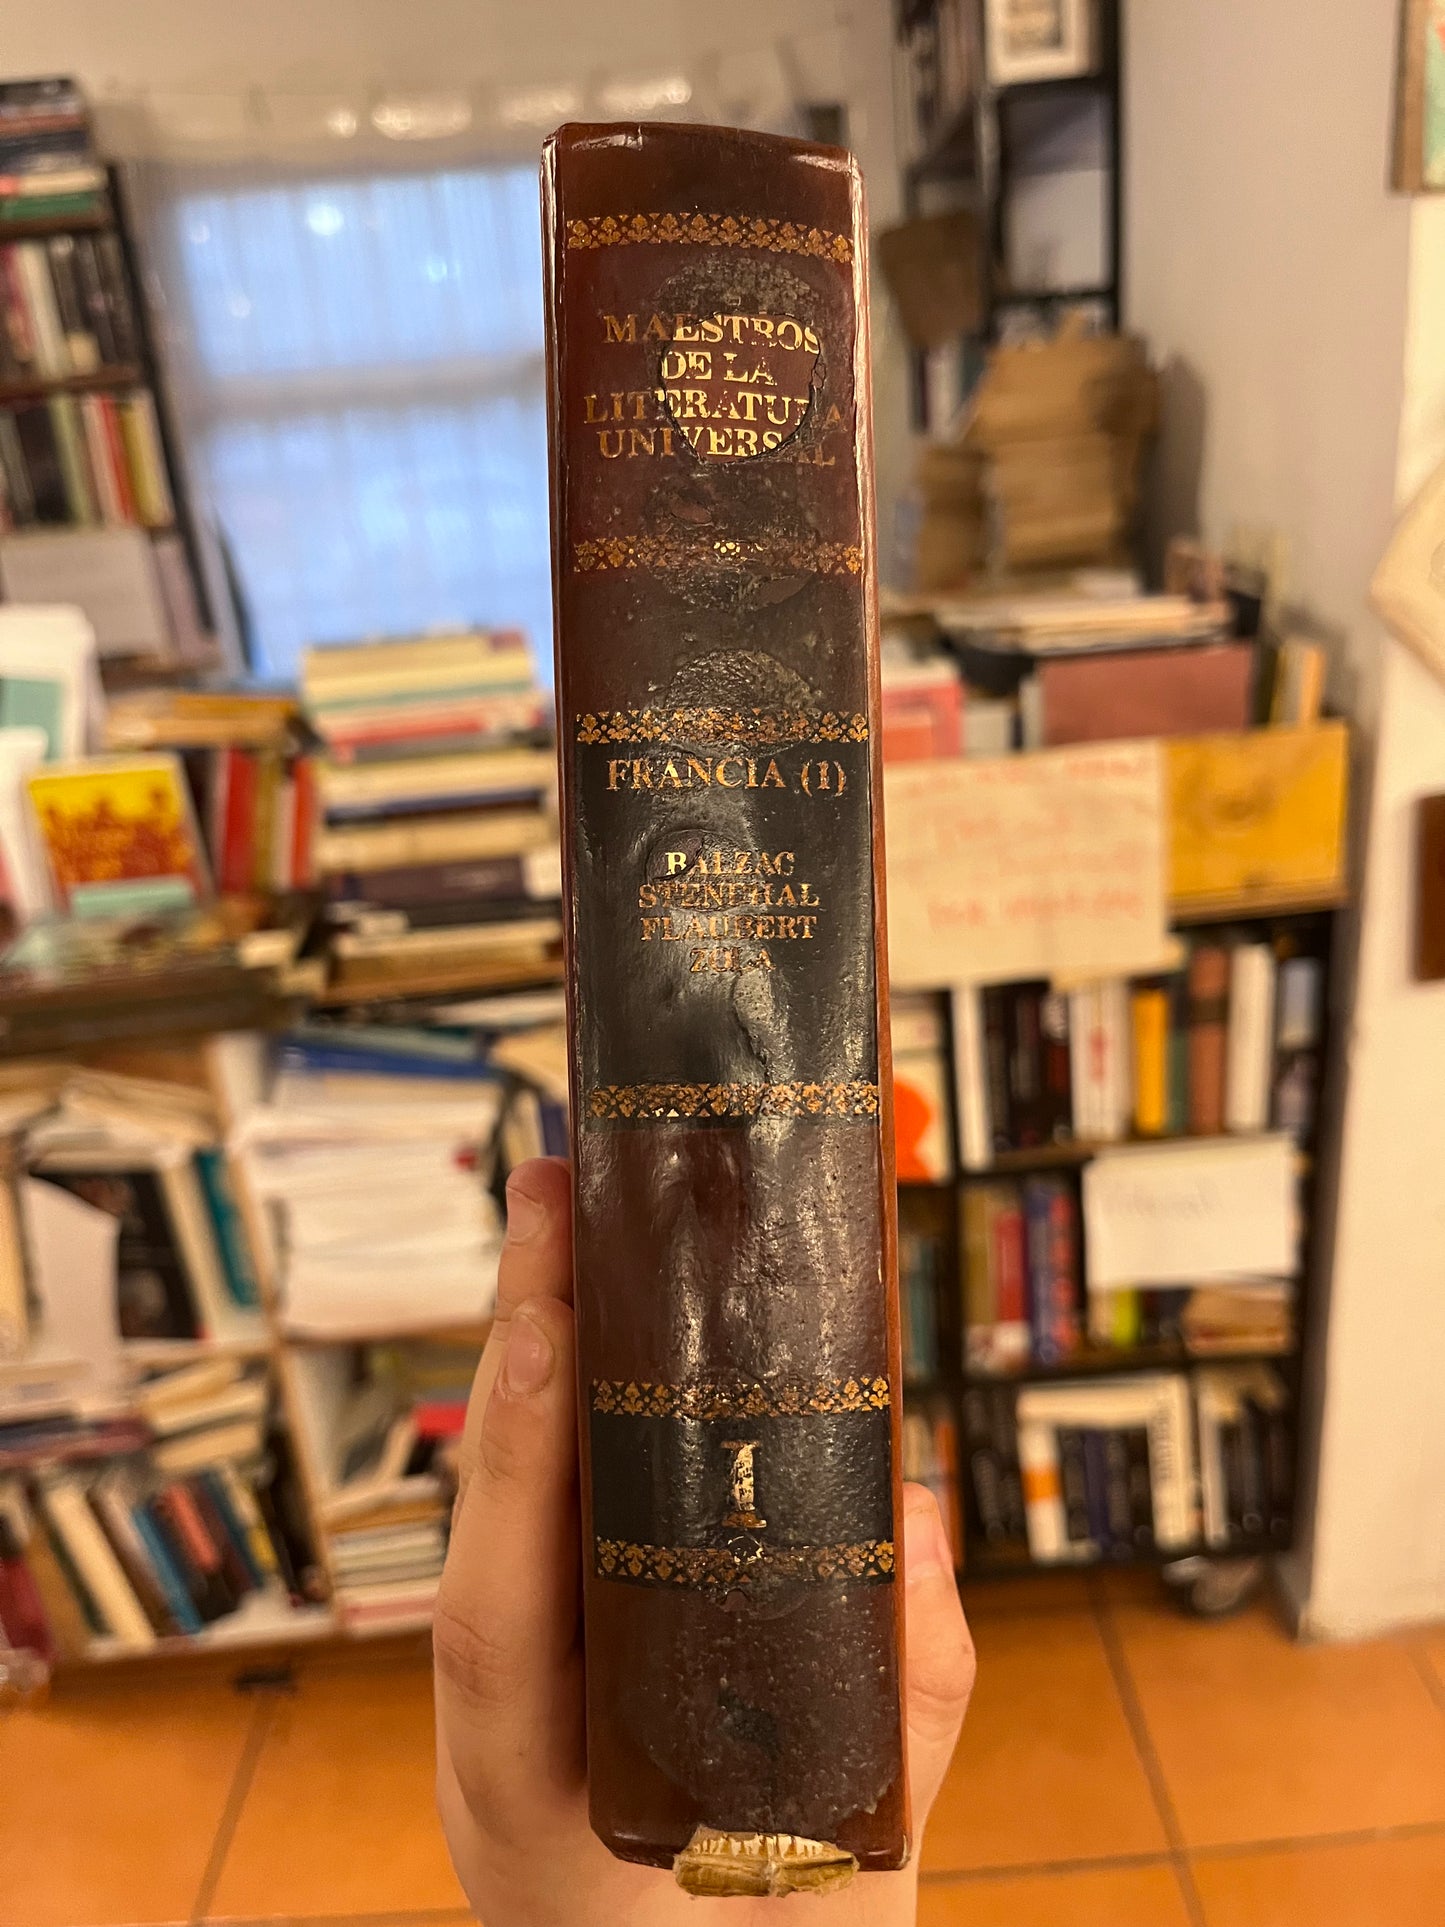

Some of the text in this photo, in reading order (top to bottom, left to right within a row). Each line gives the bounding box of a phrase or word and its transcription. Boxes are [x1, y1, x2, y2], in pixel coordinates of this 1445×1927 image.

[603, 311, 820, 355] MAESTROS
[661, 351, 778, 386] DE LA
[596, 426, 837, 467] UNIVERSL
[605, 756, 787, 792] FRANCIA
[665, 850, 796, 876] BALZAC
[639, 914, 819, 942] FLAUBERT
